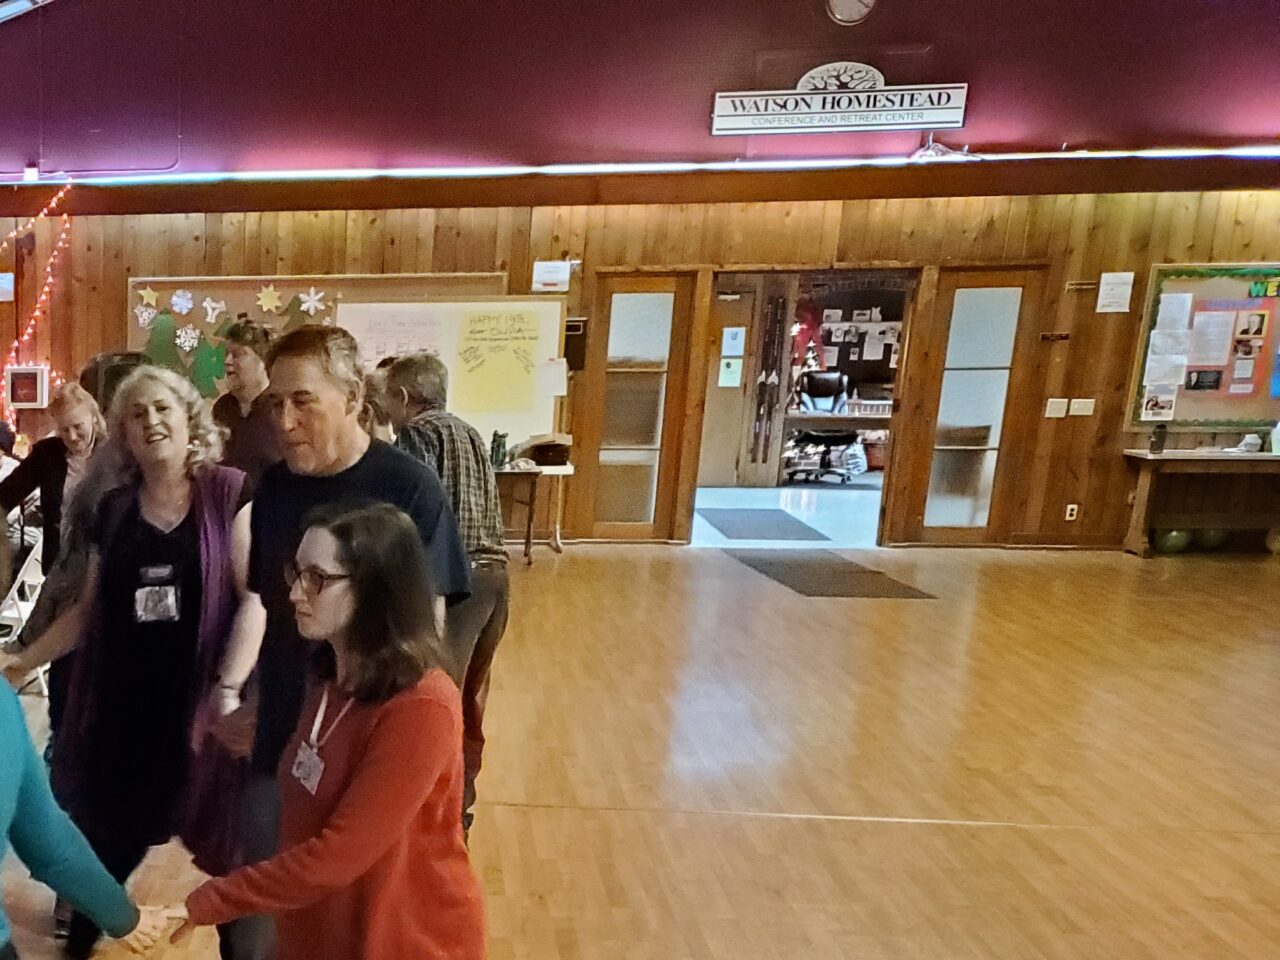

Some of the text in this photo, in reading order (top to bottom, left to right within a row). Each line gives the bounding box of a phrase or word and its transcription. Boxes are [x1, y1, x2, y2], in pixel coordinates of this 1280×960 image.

[730, 91, 952, 113] WATSON HOMESTEAD
[751, 112, 924, 126] CONFERENCE AND RETREAT CENTER
[1248, 280, 1280, 297] WE
